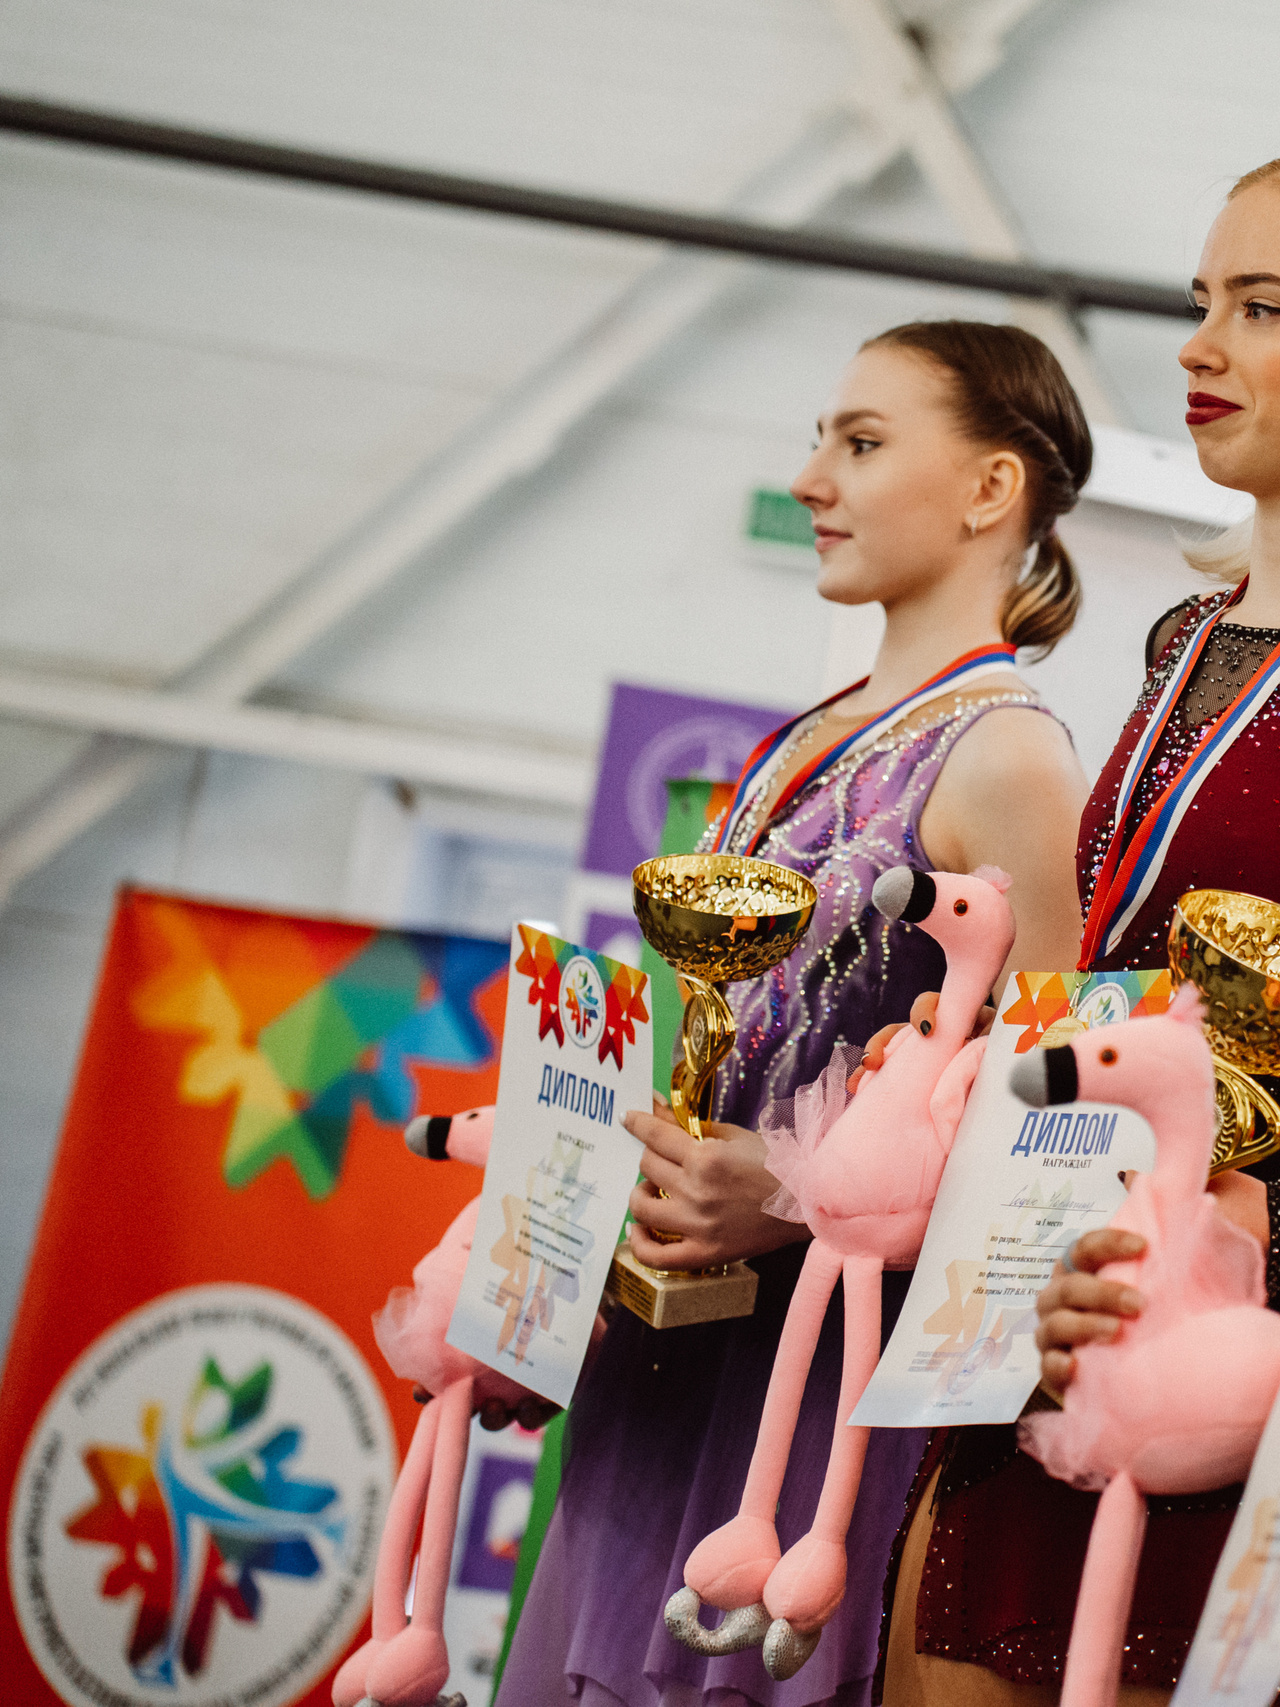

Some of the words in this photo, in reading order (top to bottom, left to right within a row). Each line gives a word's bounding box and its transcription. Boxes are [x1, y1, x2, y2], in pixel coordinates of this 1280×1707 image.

[538, 1064, 614, 1127] ДИПЛОМ
[1010, 1111, 1118, 1157] ДИПЛОМ
[1042, 1158, 1092, 1169] НАГРАЖДАЕТ
[994, 1253, 1037, 1264] Всероссийских
[986, 1270, 1017, 1280] фигурному
